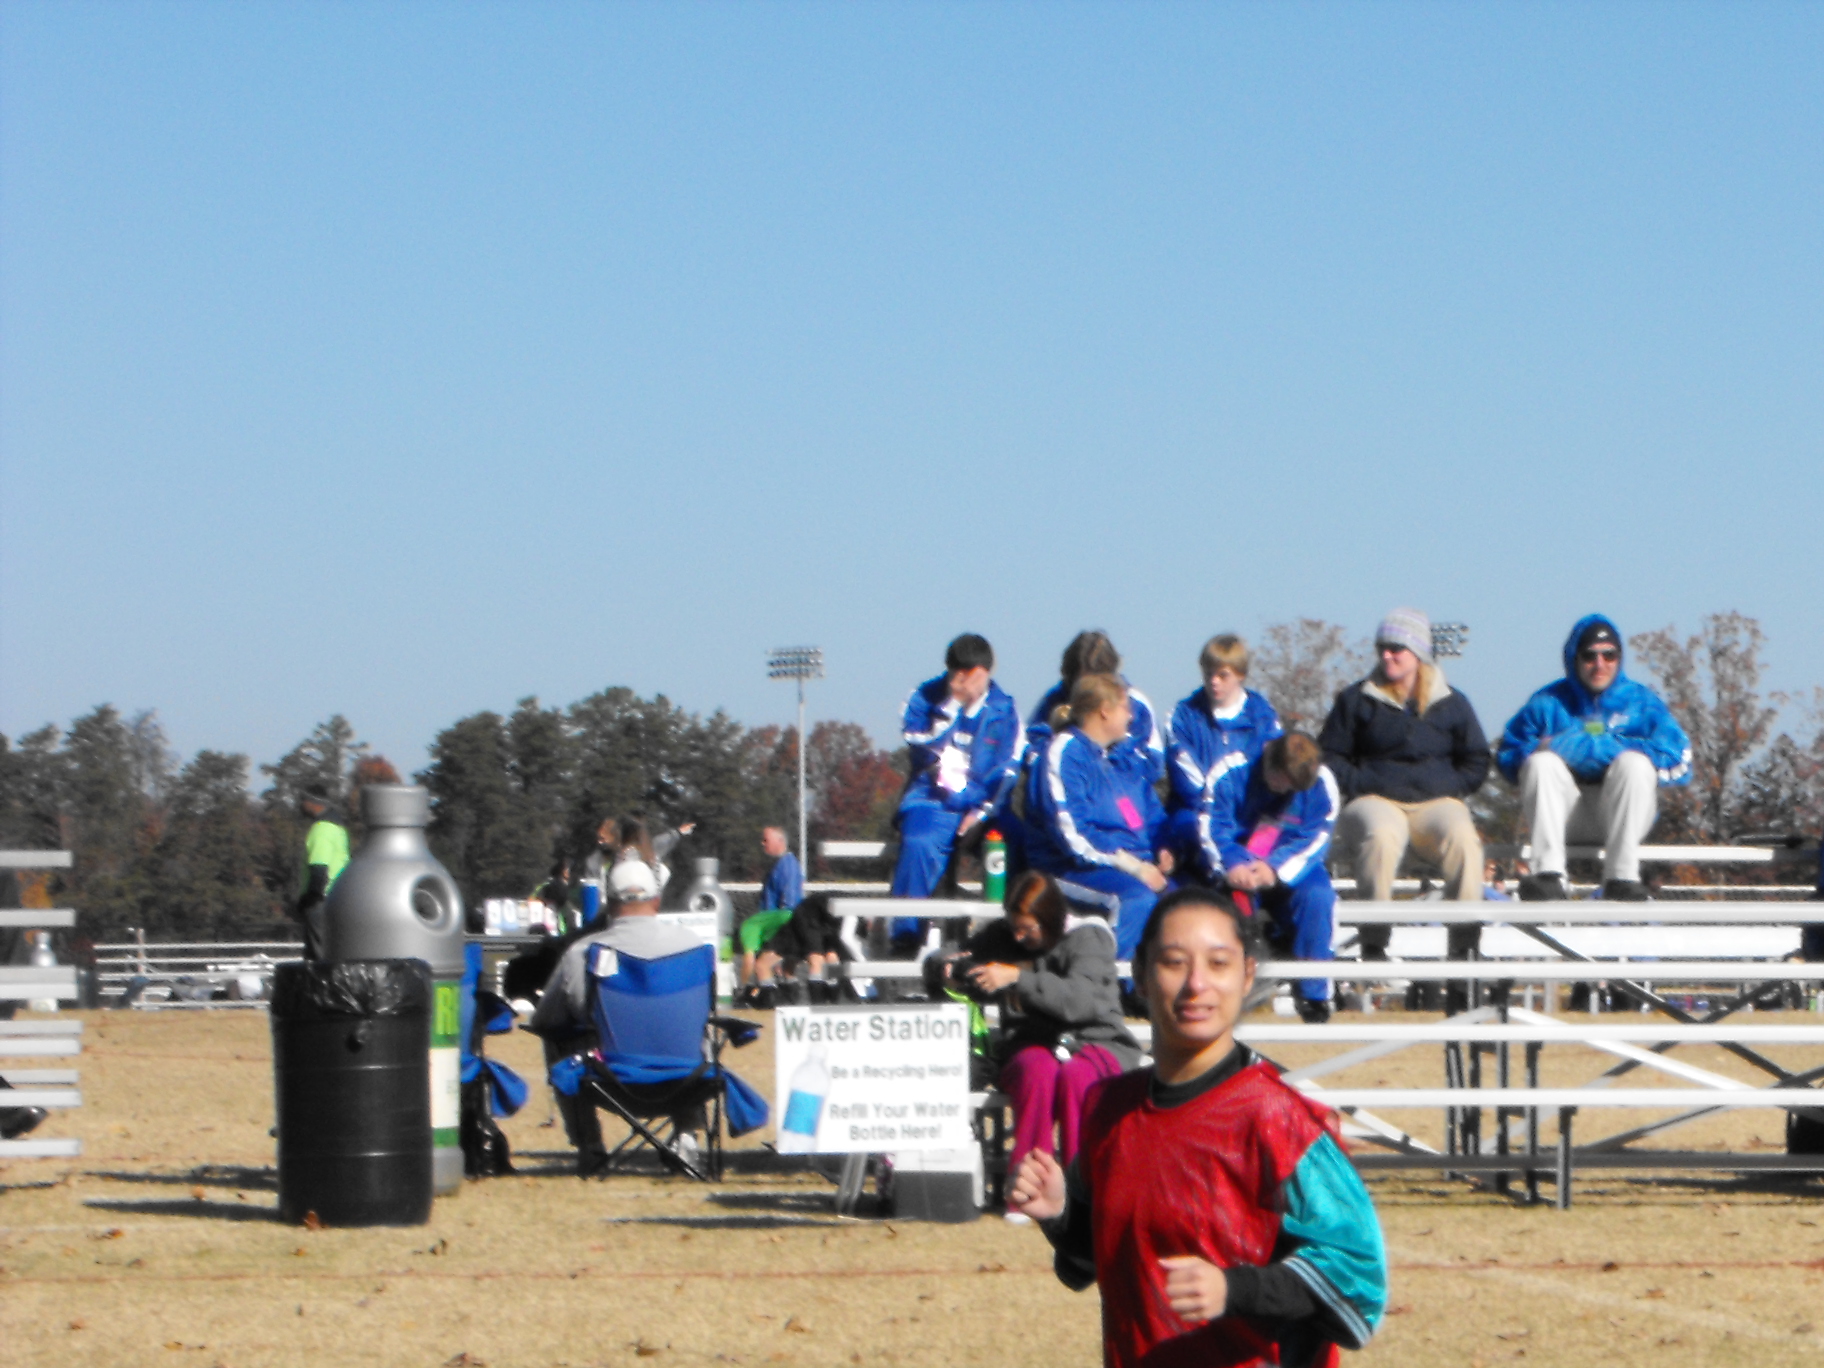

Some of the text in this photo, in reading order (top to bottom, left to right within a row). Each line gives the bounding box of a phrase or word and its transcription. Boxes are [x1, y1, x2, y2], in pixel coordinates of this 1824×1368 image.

[782, 1014, 962, 1042] Water Station
[831, 1064, 962, 1081] Be a Recycling Hero!
[830, 1103, 960, 1119] Refill Your Water
[849, 1124, 942, 1140] Bottle Here!
